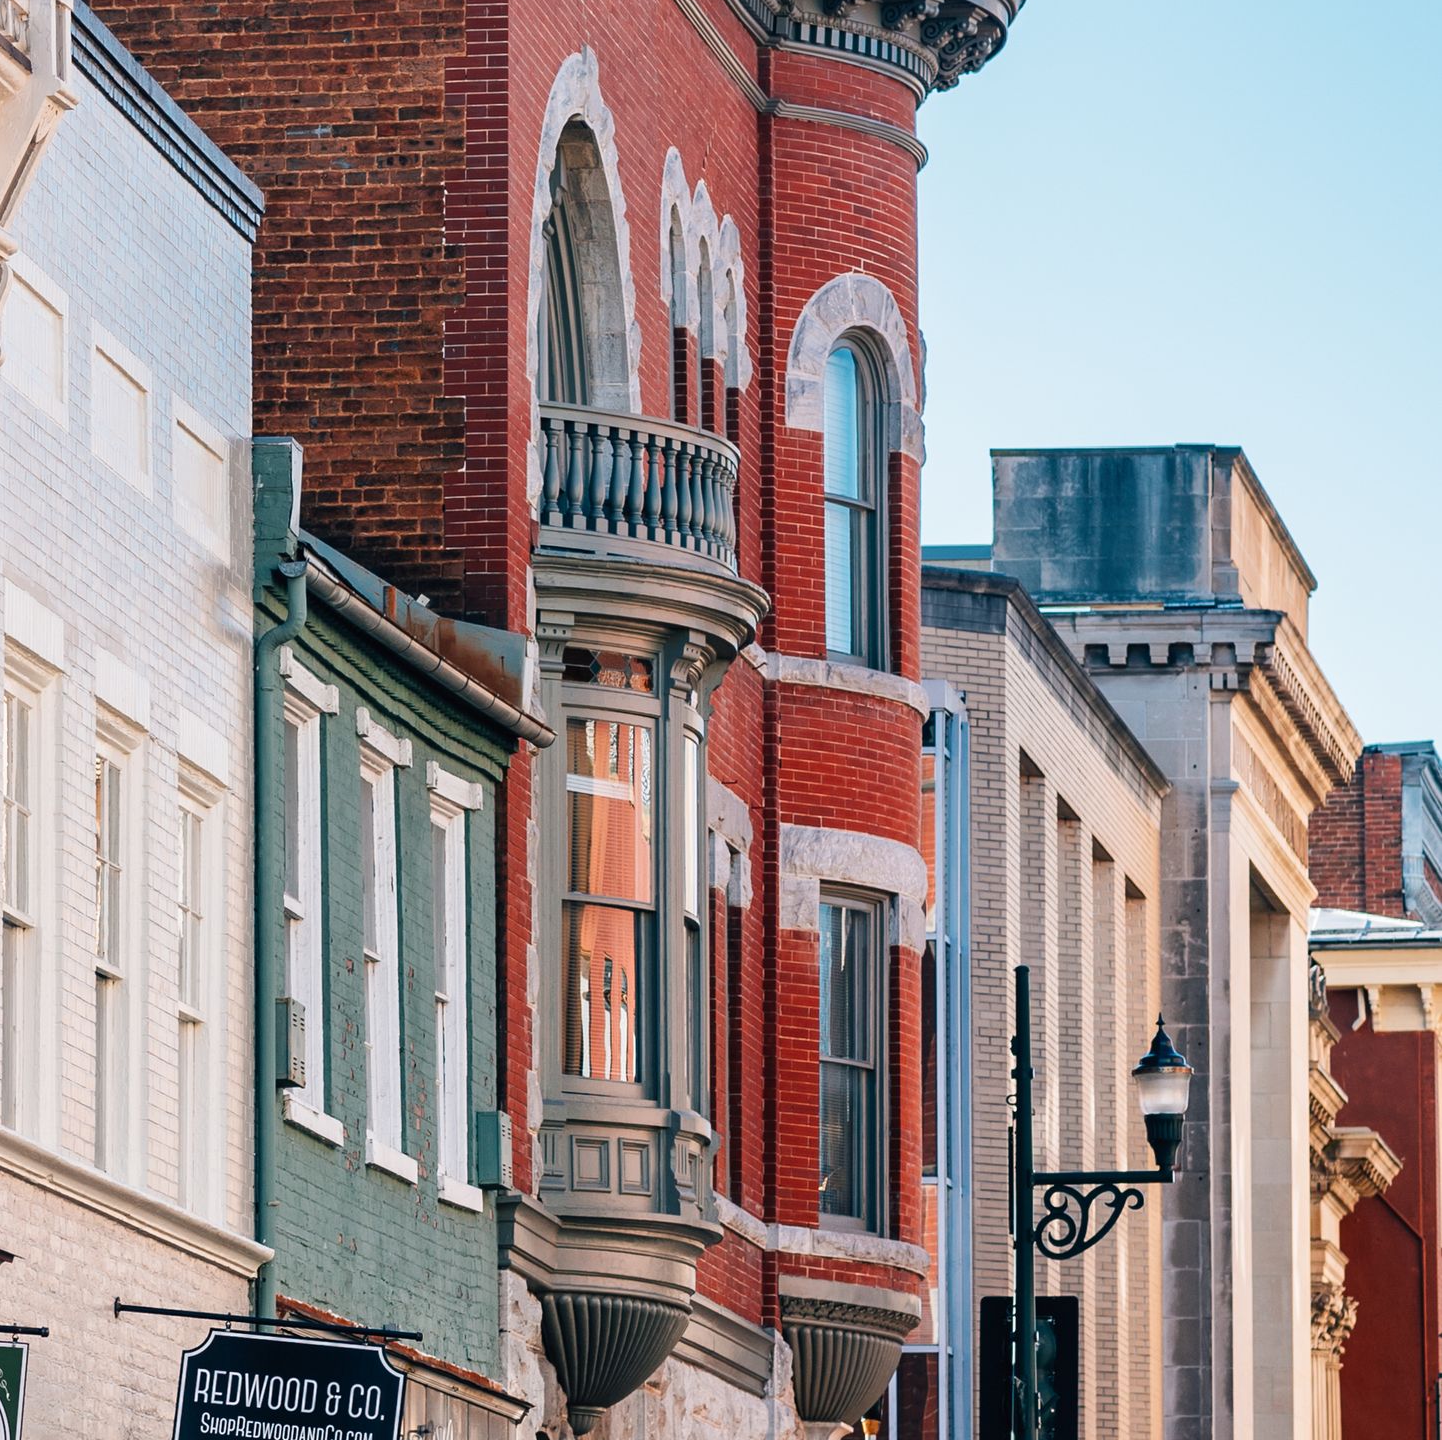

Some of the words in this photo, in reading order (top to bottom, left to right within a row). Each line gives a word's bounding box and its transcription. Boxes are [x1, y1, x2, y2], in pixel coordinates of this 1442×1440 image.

[193, 1367, 318, 1414] REDWOOD
[325, 1380, 342, 1417] &
[348, 1383, 386, 1422] CO.
